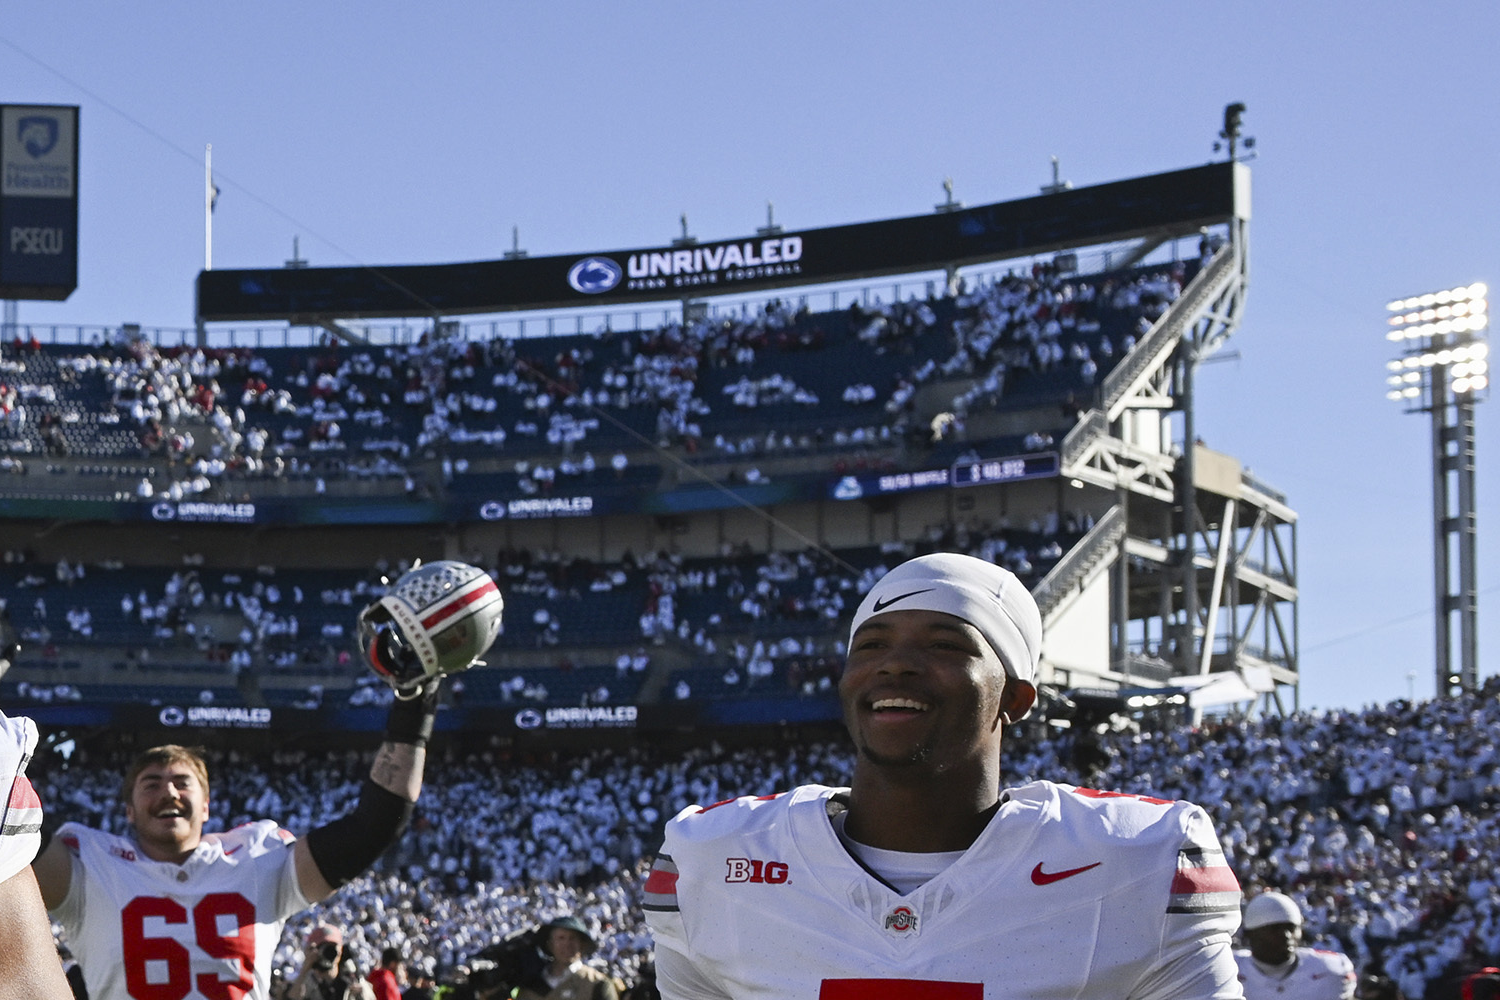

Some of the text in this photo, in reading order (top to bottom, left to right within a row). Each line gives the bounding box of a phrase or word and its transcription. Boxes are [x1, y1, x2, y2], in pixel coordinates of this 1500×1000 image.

[10, 227, 64, 255] PSECU
[627, 236, 803, 279] UNRIVALED
[177, 502, 256, 518] UNRIVALED
[507, 496, 594, 515] UNRIVALED
[187, 706, 272, 724] UNRIVALED
[545, 705, 638, 723] UNRIVALED
